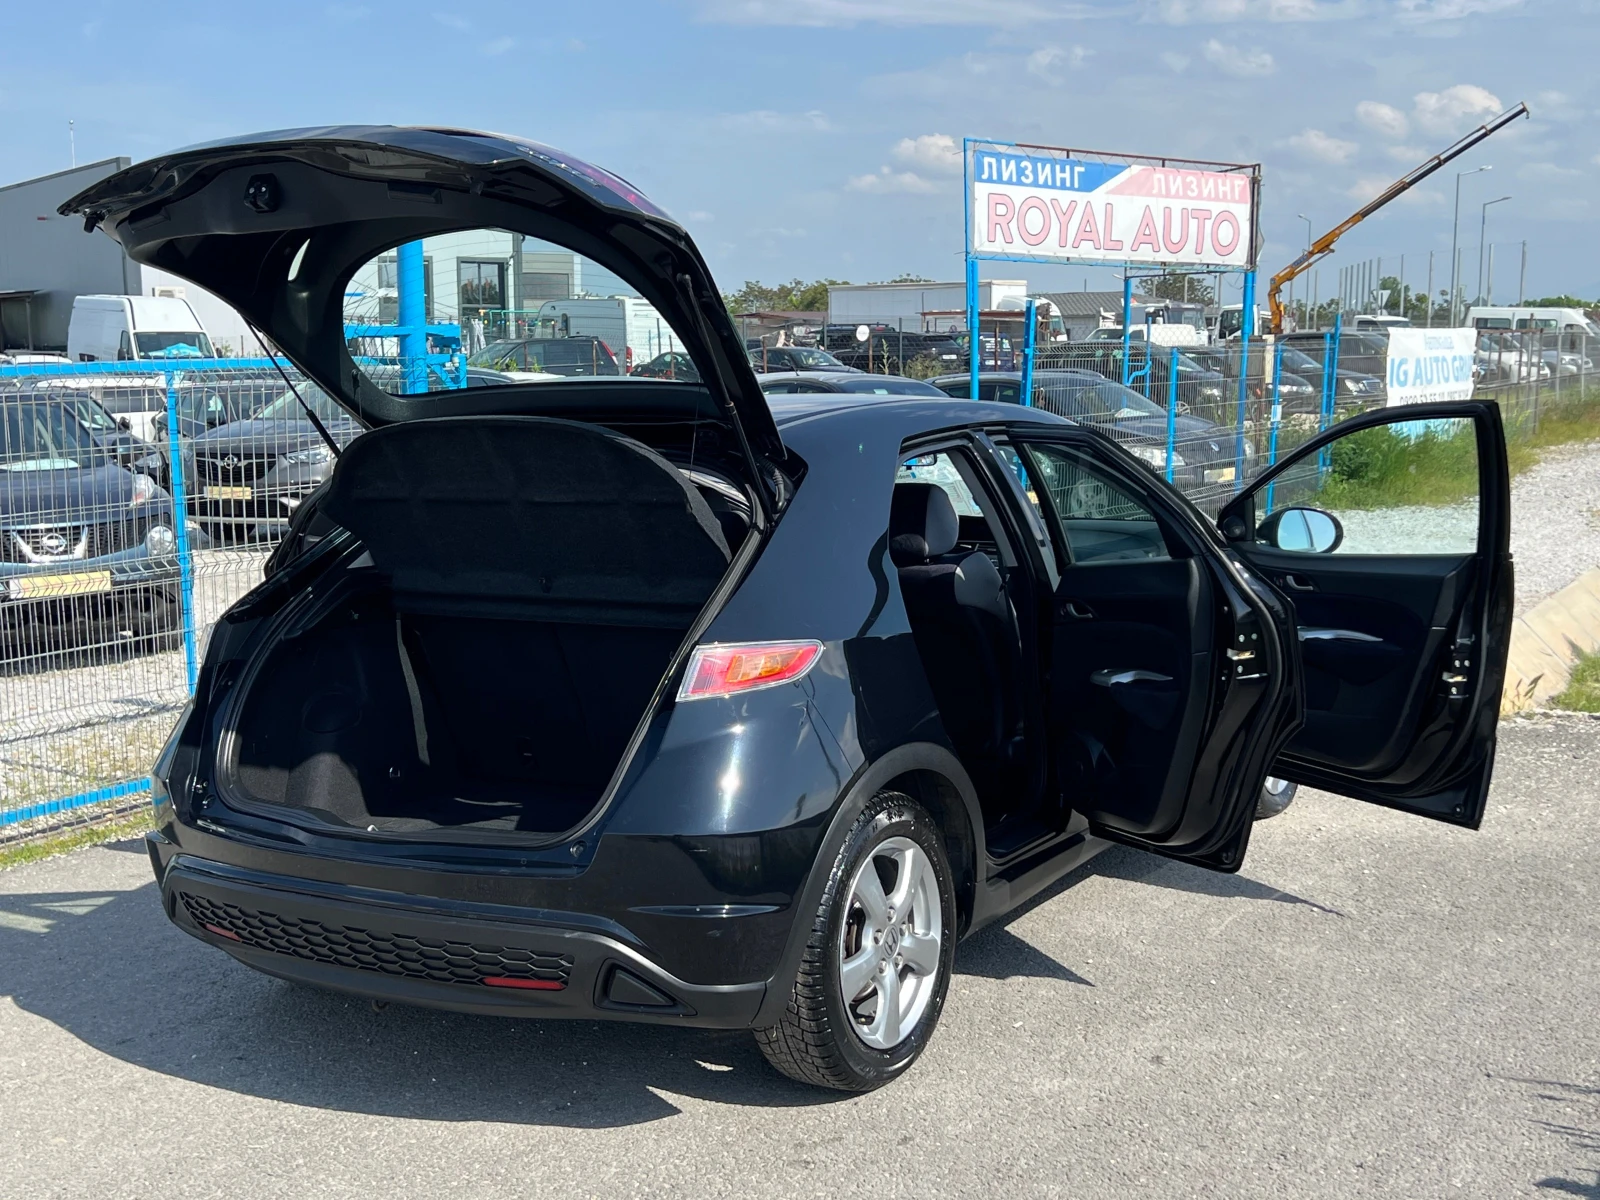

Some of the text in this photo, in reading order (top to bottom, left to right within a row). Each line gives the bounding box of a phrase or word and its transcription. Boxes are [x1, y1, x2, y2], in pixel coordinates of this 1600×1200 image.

[981, 156, 1085, 189] ЛИЗИНГ
[1152, 173, 1244, 201] ЛИЗИНГ
[987, 193, 1240, 257] ROYAL AUTO
[1389, 357, 1409, 388] IG
[1412, 355, 1450, 386] AUTO
